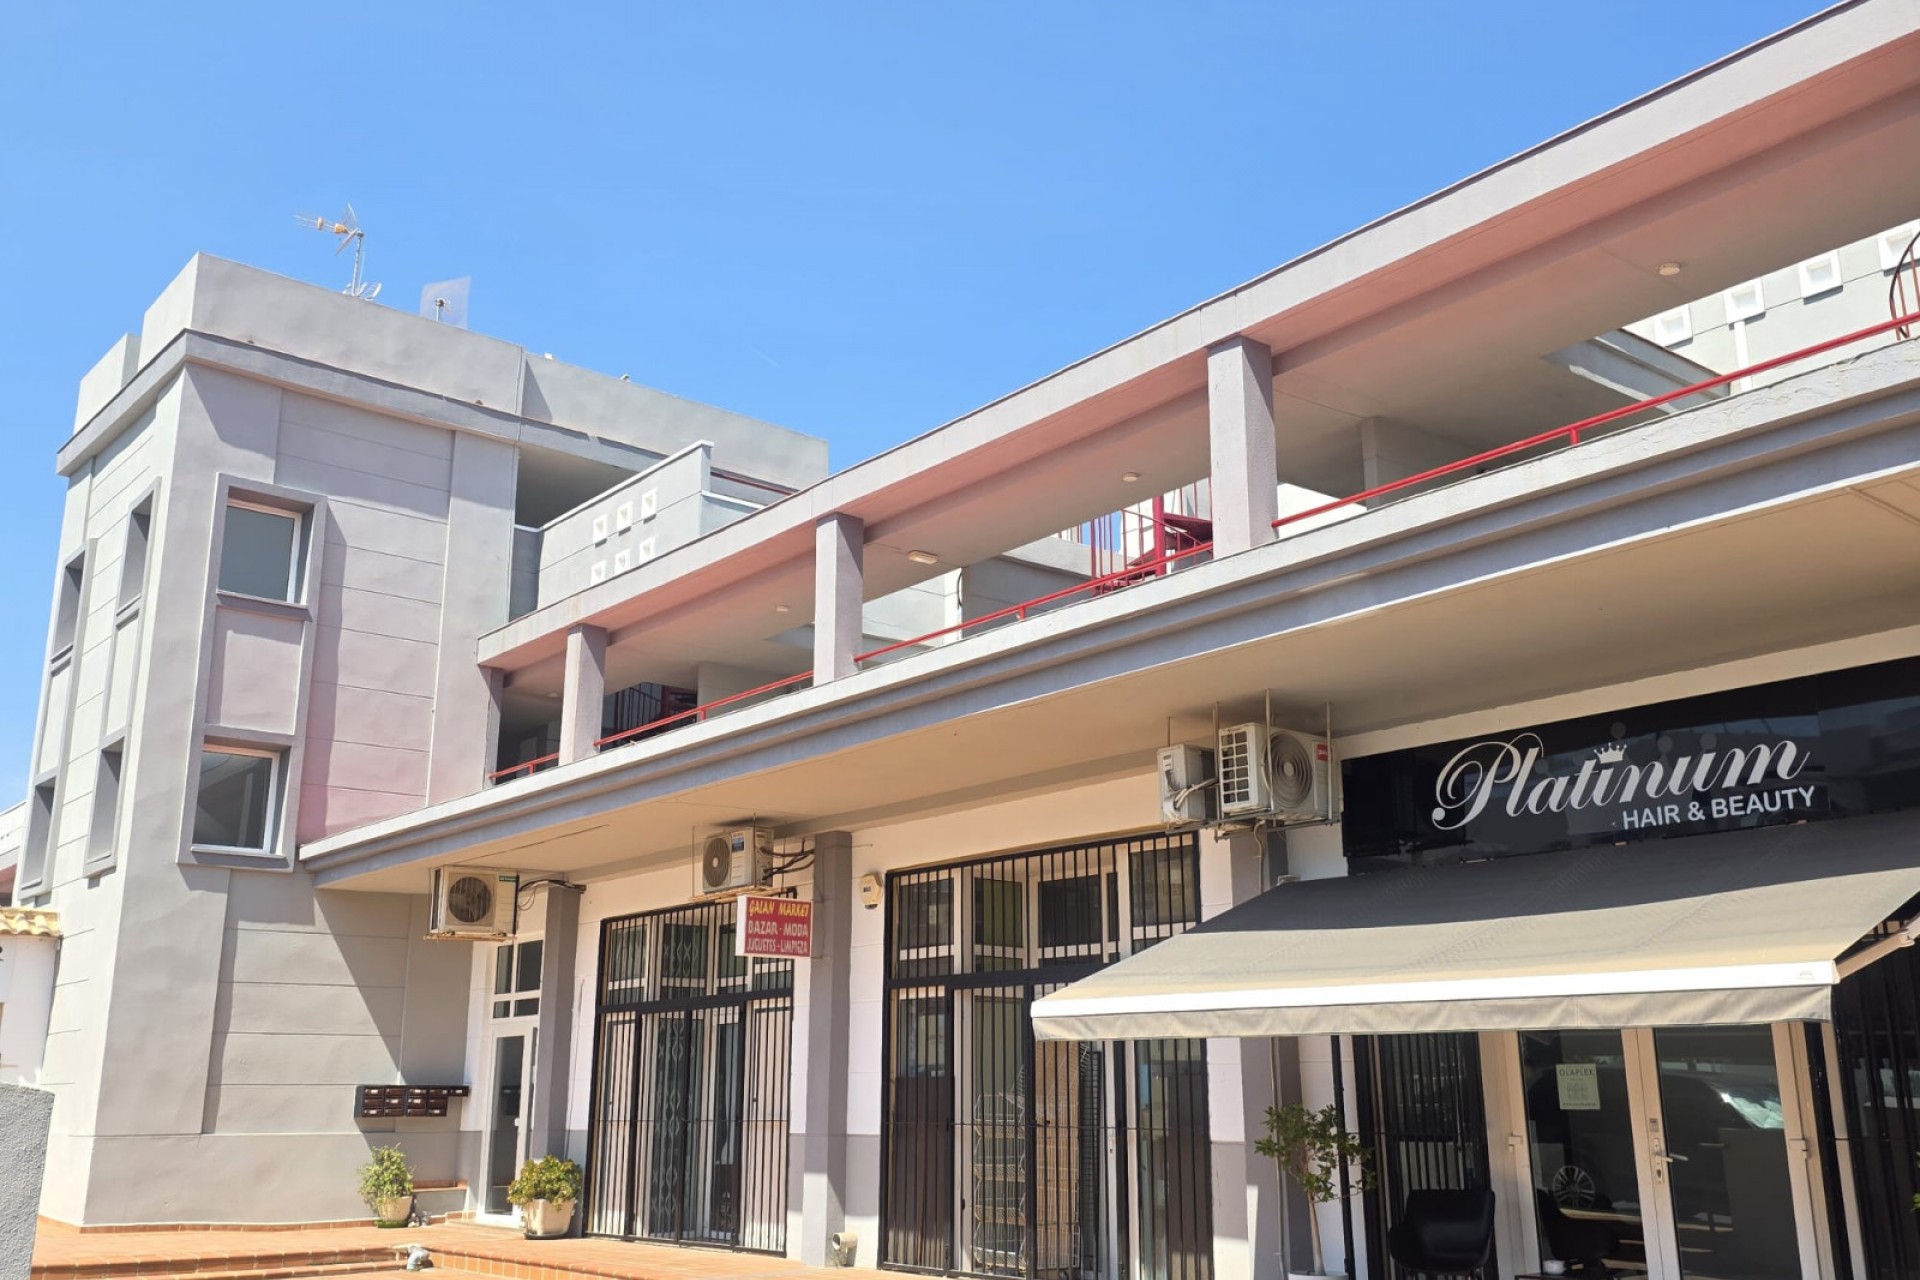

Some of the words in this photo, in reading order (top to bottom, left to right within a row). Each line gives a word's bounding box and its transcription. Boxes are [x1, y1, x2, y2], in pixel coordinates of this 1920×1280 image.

[1431, 732, 1811, 831] Platinum
[1622, 803, 1681, 830] HAIR
[1687, 801, 1706, 821] &
[1711, 785, 1816, 820] BEAUTY
[778, 901, 810, 917] MARKET
[748, 920, 778, 935] BAZAR
[783, 922, 808, 937] MODA
[747, 938, 776, 952] JUGUETES
